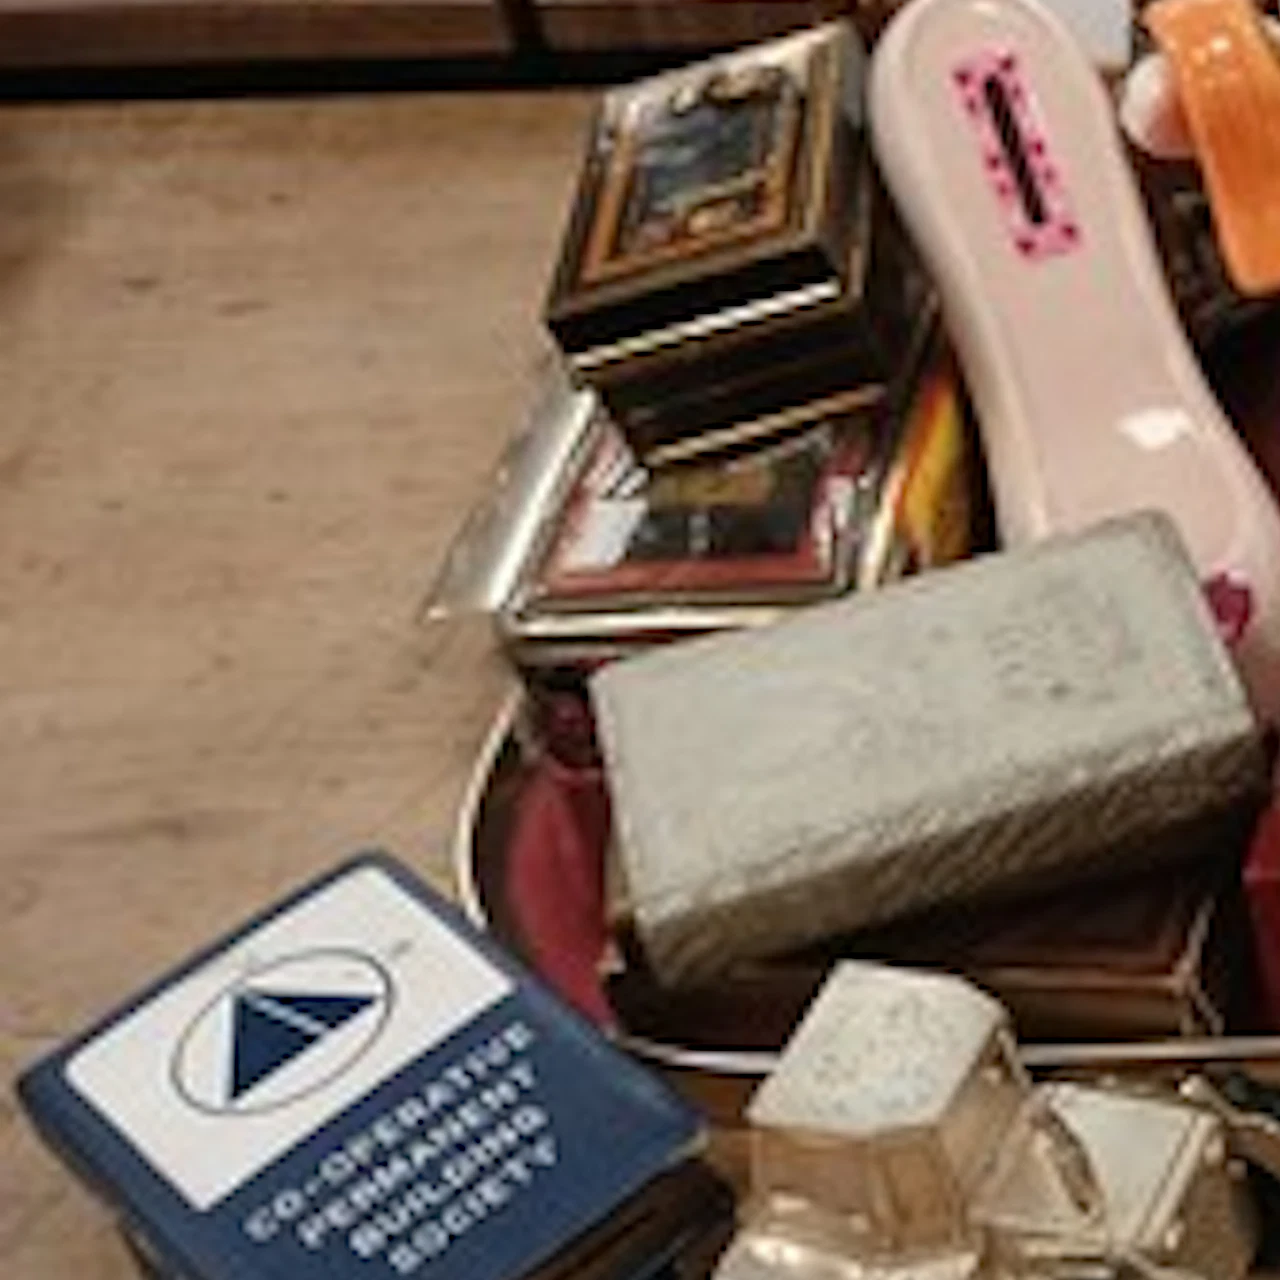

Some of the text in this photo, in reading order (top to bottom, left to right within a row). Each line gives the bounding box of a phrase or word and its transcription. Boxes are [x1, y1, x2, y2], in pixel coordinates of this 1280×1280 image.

[243, 1020, 535, 1244] CO-OPERATIVE
[297, 1060, 535, 1250] PERMANENT
[350, 1104, 548, 1258] BUILDING
